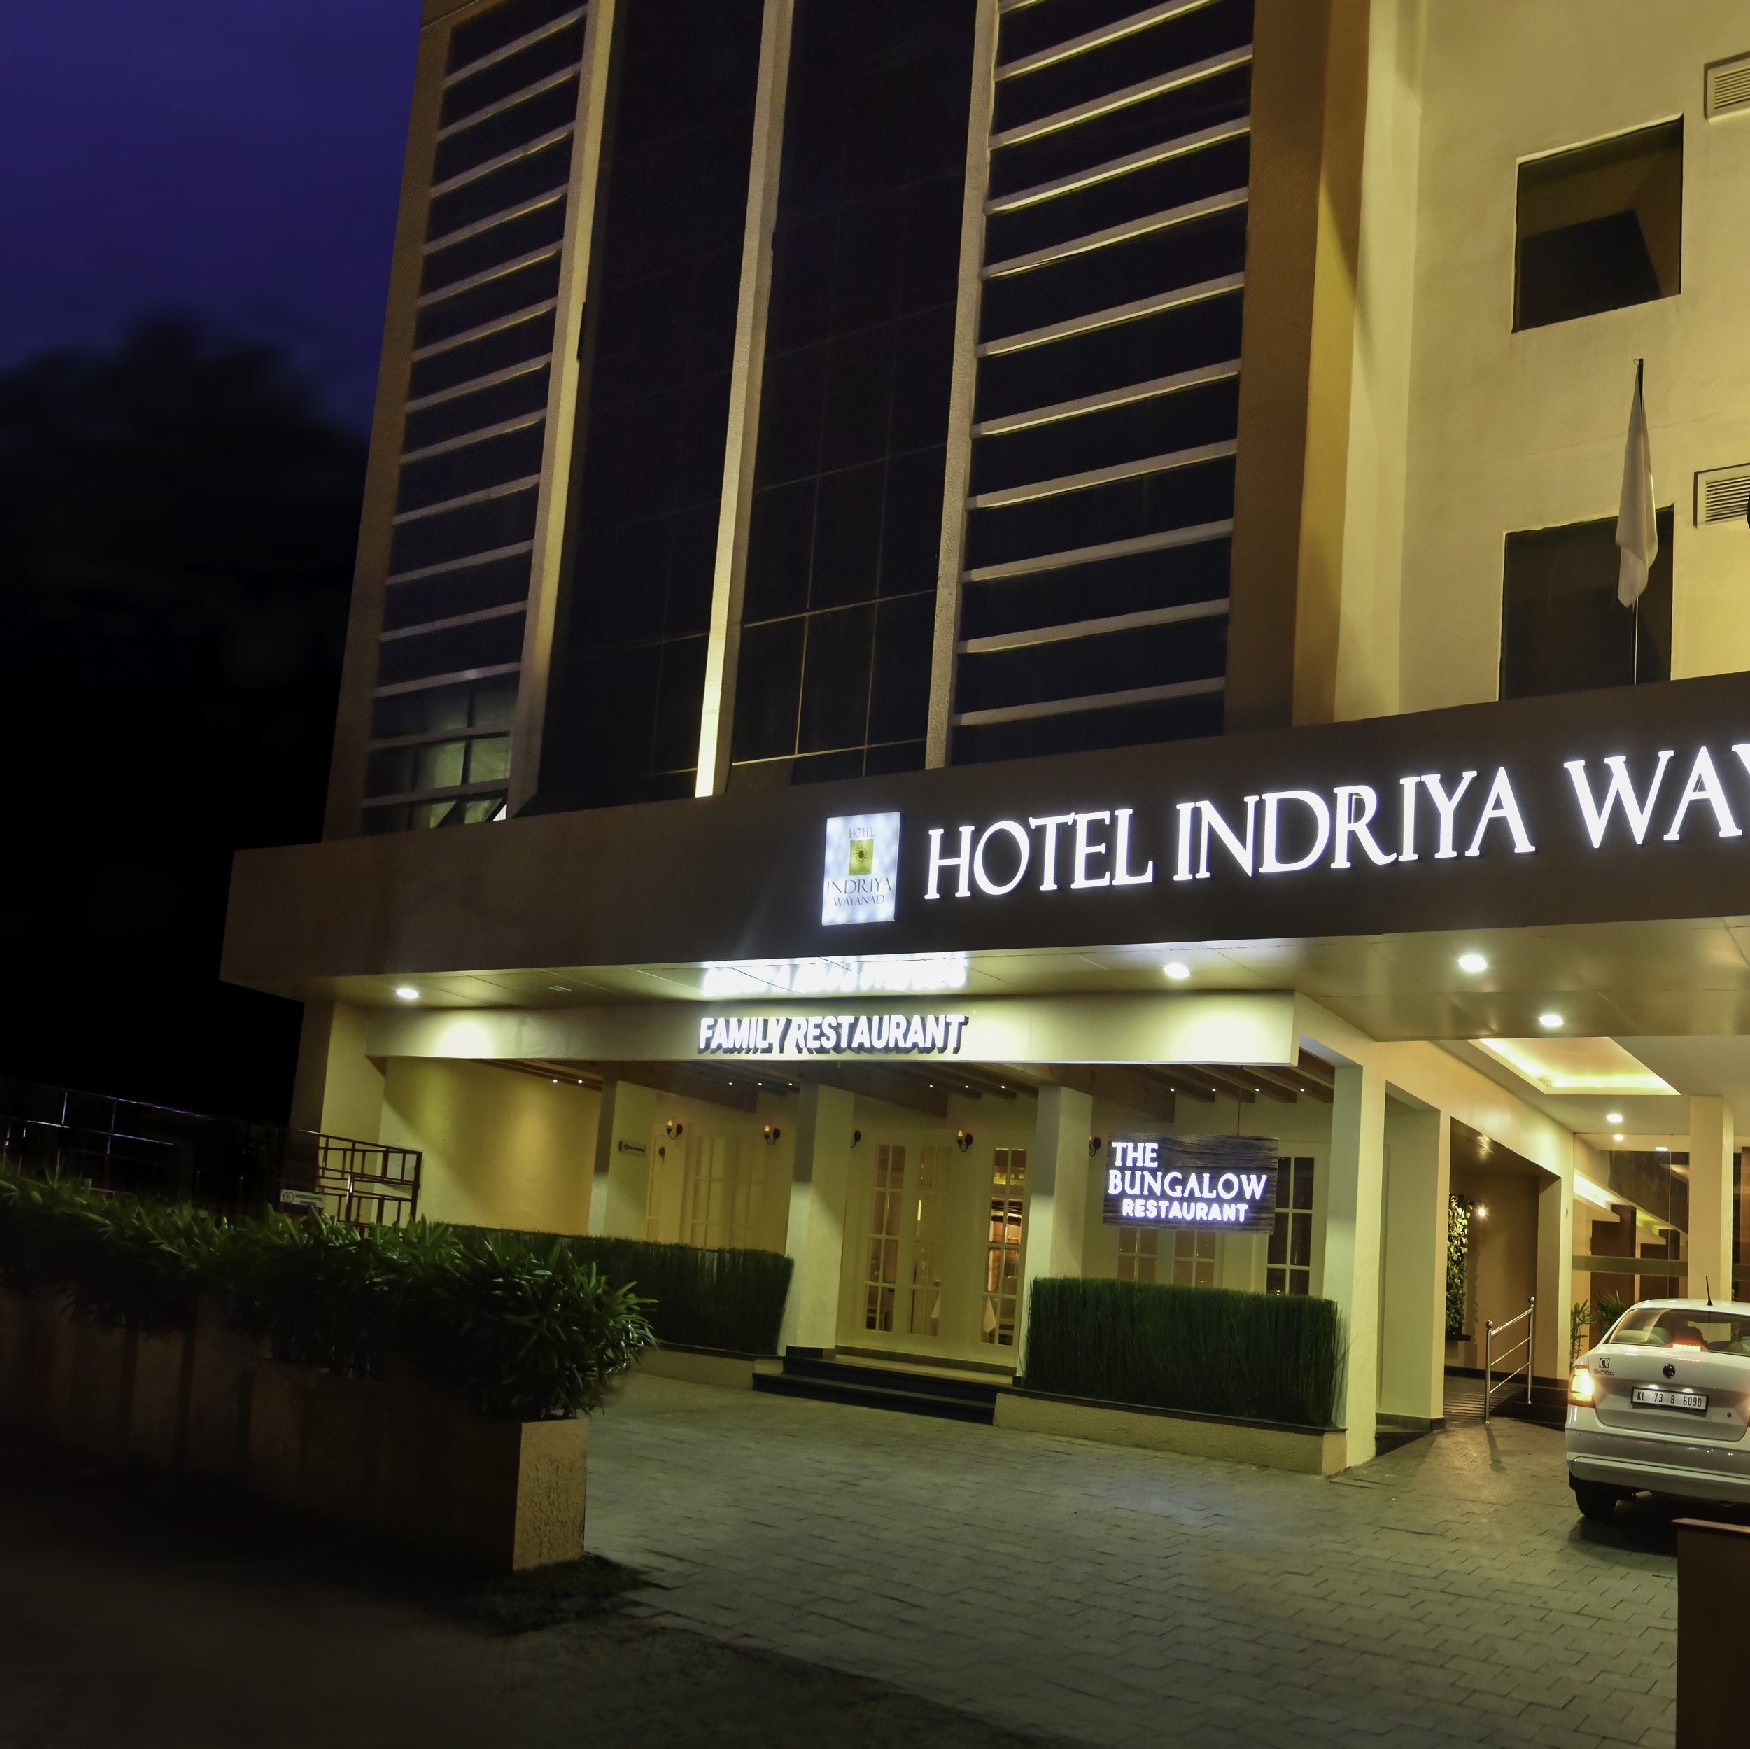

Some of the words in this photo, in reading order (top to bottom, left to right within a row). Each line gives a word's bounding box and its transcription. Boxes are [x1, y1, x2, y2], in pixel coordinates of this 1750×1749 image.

[924, 808, 1154, 900] HOTEL
[1173, 766, 1535, 882] INDRIYA
[827, 876, 892, 895] INDRIYA
[833, 894, 885, 907] WAYANAD
[699, 1016, 789, 1050] FAMILY
[793, 1013, 967, 1051] RESTAURANT
[1111, 1141, 1159, 1168] THE
[1107, 1169, 1267, 1200] BUNGALOW
[1122, 1199, 1248, 1222] RESTAURANT
[1654, 1392, 1664, 1403] 73
